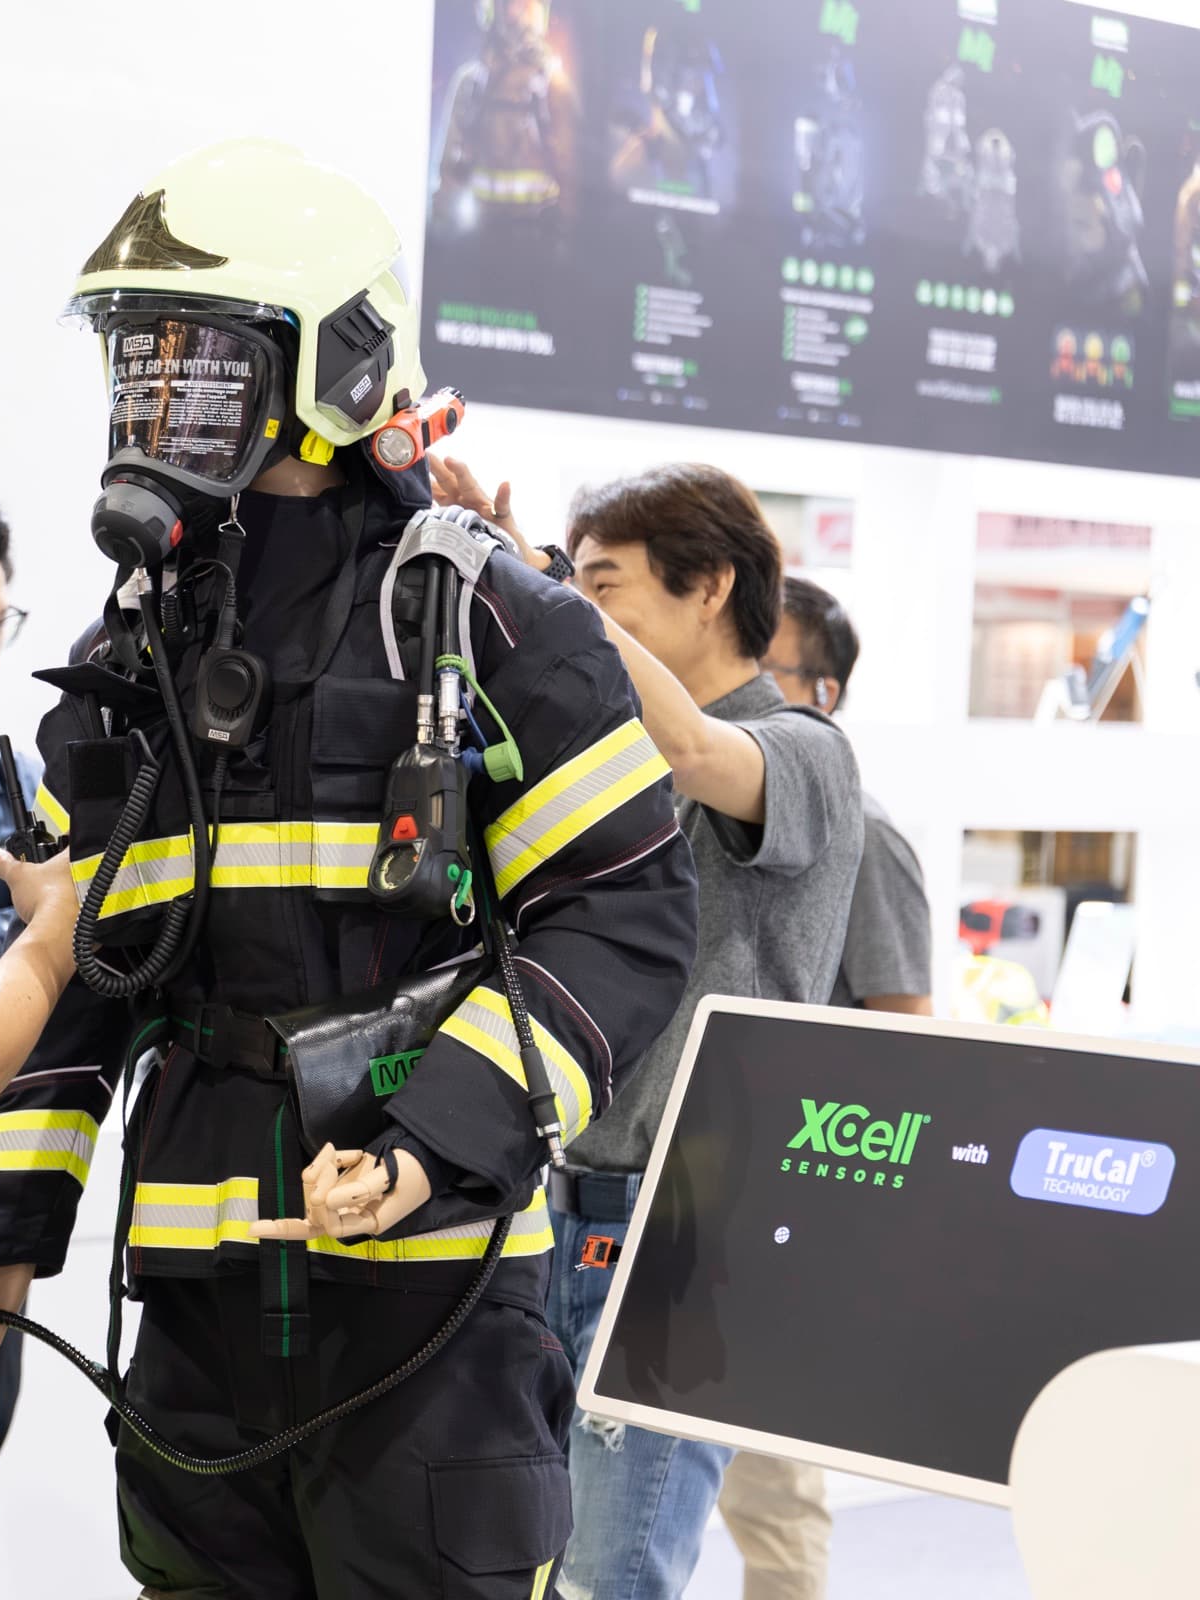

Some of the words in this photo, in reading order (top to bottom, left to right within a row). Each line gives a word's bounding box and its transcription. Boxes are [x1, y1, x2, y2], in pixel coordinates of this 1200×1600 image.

[124, 337, 152, 350] MSA
[129, 360, 144, 376] WE
[145, 360, 161, 375] GO
[164, 359, 179, 374] IN
[183, 359, 220, 376] WITH
[223, 361, 252, 377] YOU.
[352, 377, 370, 399] MSA
[952, 1143, 989, 1165] with
[780, 1157, 905, 1190] SENSORS
[1042, 1177, 1131, 1203] TECHNOLOGY
